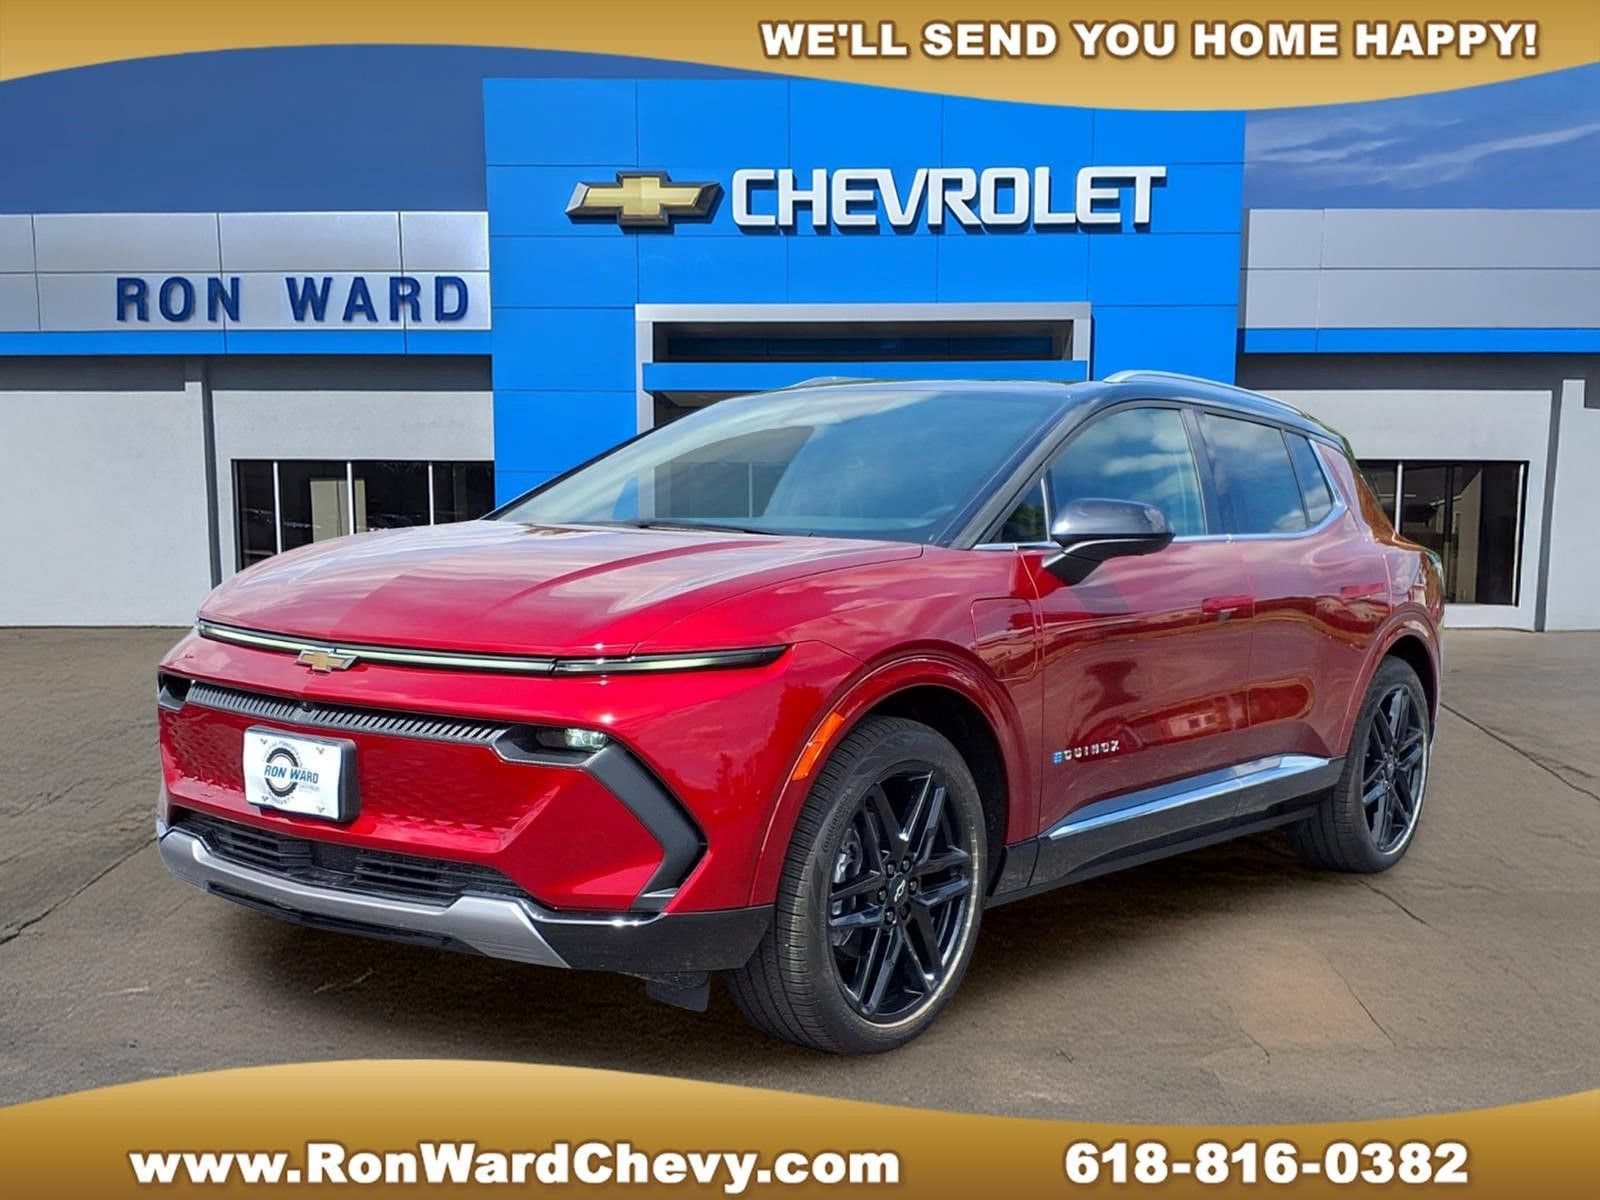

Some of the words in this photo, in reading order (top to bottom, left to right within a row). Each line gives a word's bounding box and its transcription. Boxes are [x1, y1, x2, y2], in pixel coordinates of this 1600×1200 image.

[732, 166, 1166, 227] CHEVROLET
[116, 277, 240, 322] RON
[286, 276, 469, 323] WARD
[264, 765, 287, 778] RON
[290, 768, 319, 784] WARD
